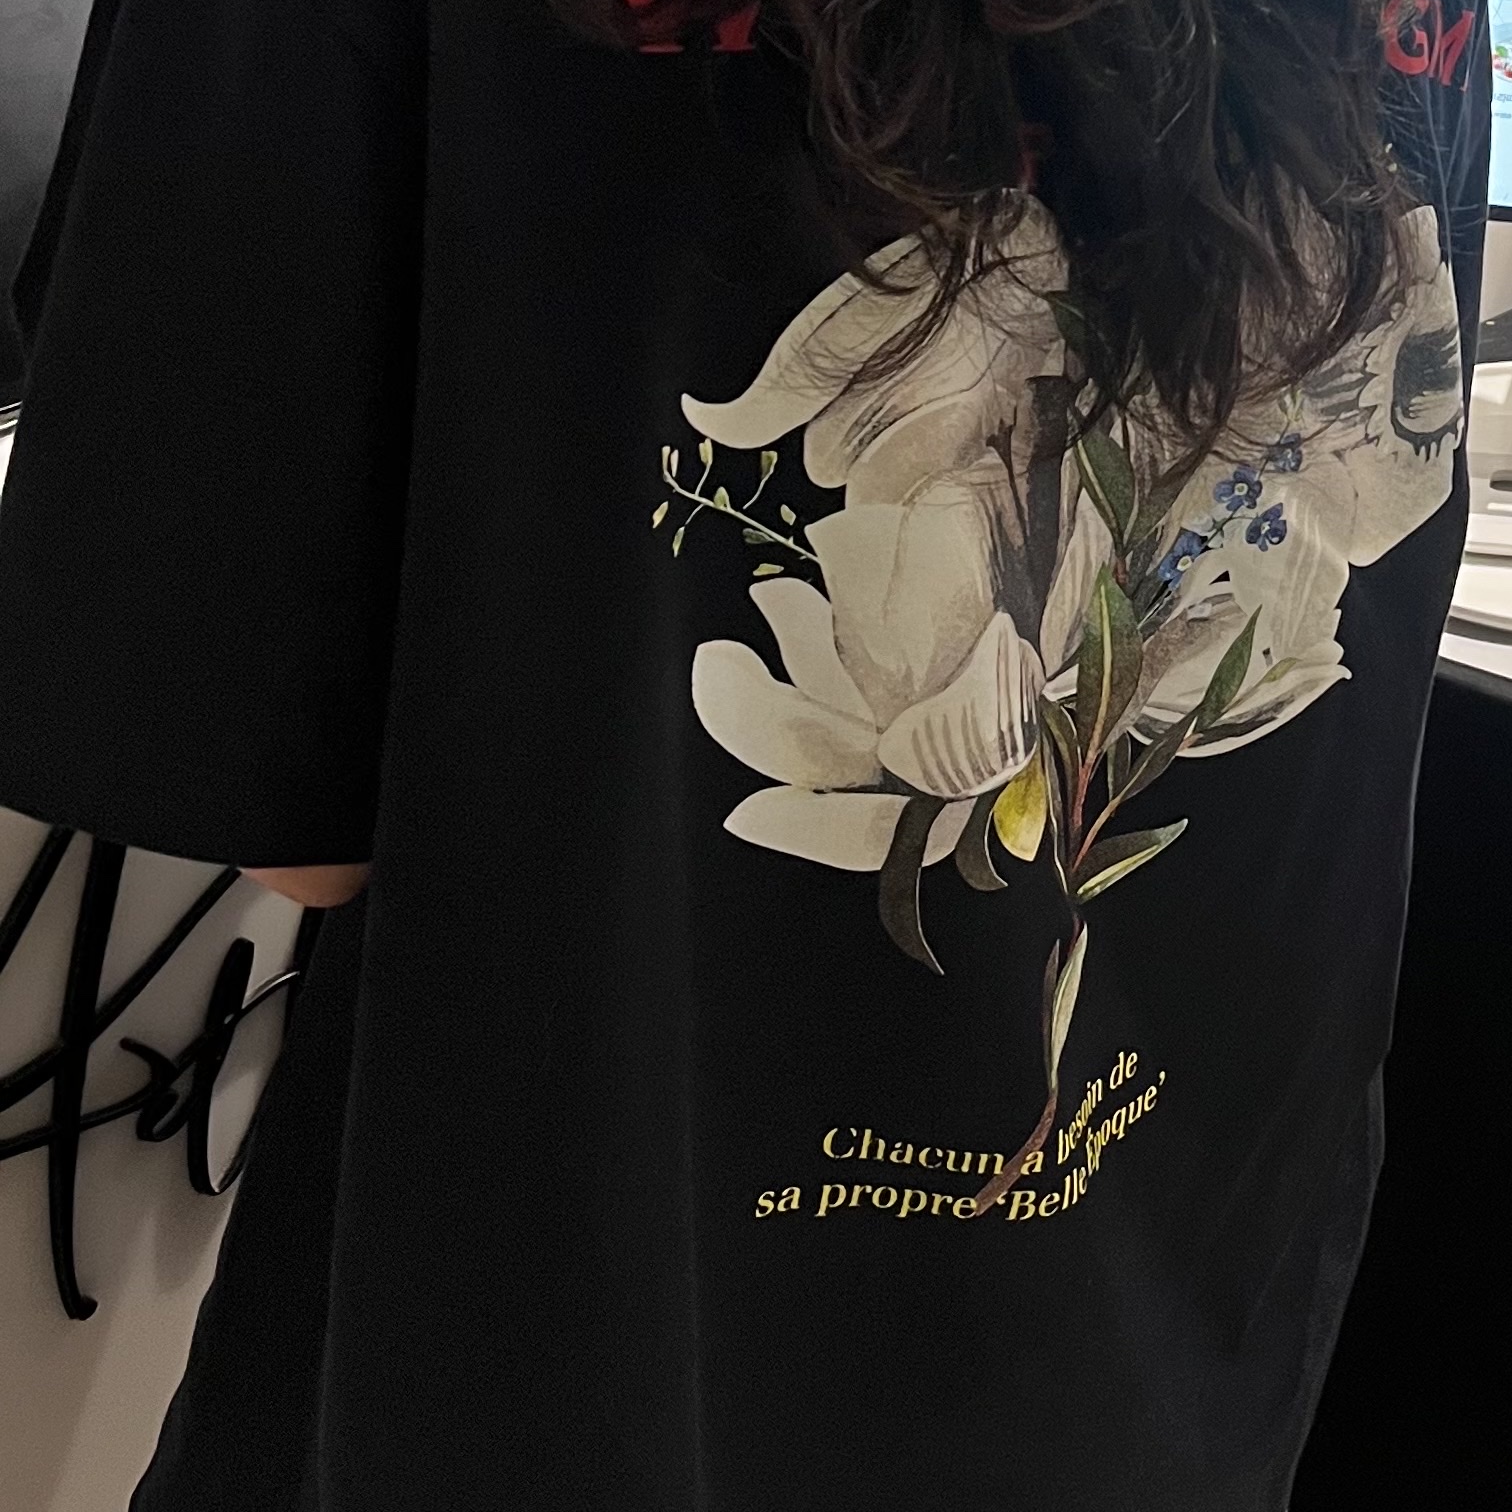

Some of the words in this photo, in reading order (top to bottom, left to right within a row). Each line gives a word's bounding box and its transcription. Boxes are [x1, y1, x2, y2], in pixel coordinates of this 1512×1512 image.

[821, 1126, 1004, 1176] Chacun
[1020, 1147, 1044, 1176] a
[1056, 1077, 1103, 1166] besoin
[1108, 1050, 1139, 1091] de
[755, 1182, 801, 1218] sa
[814, 1182, 978, 1220] propre
